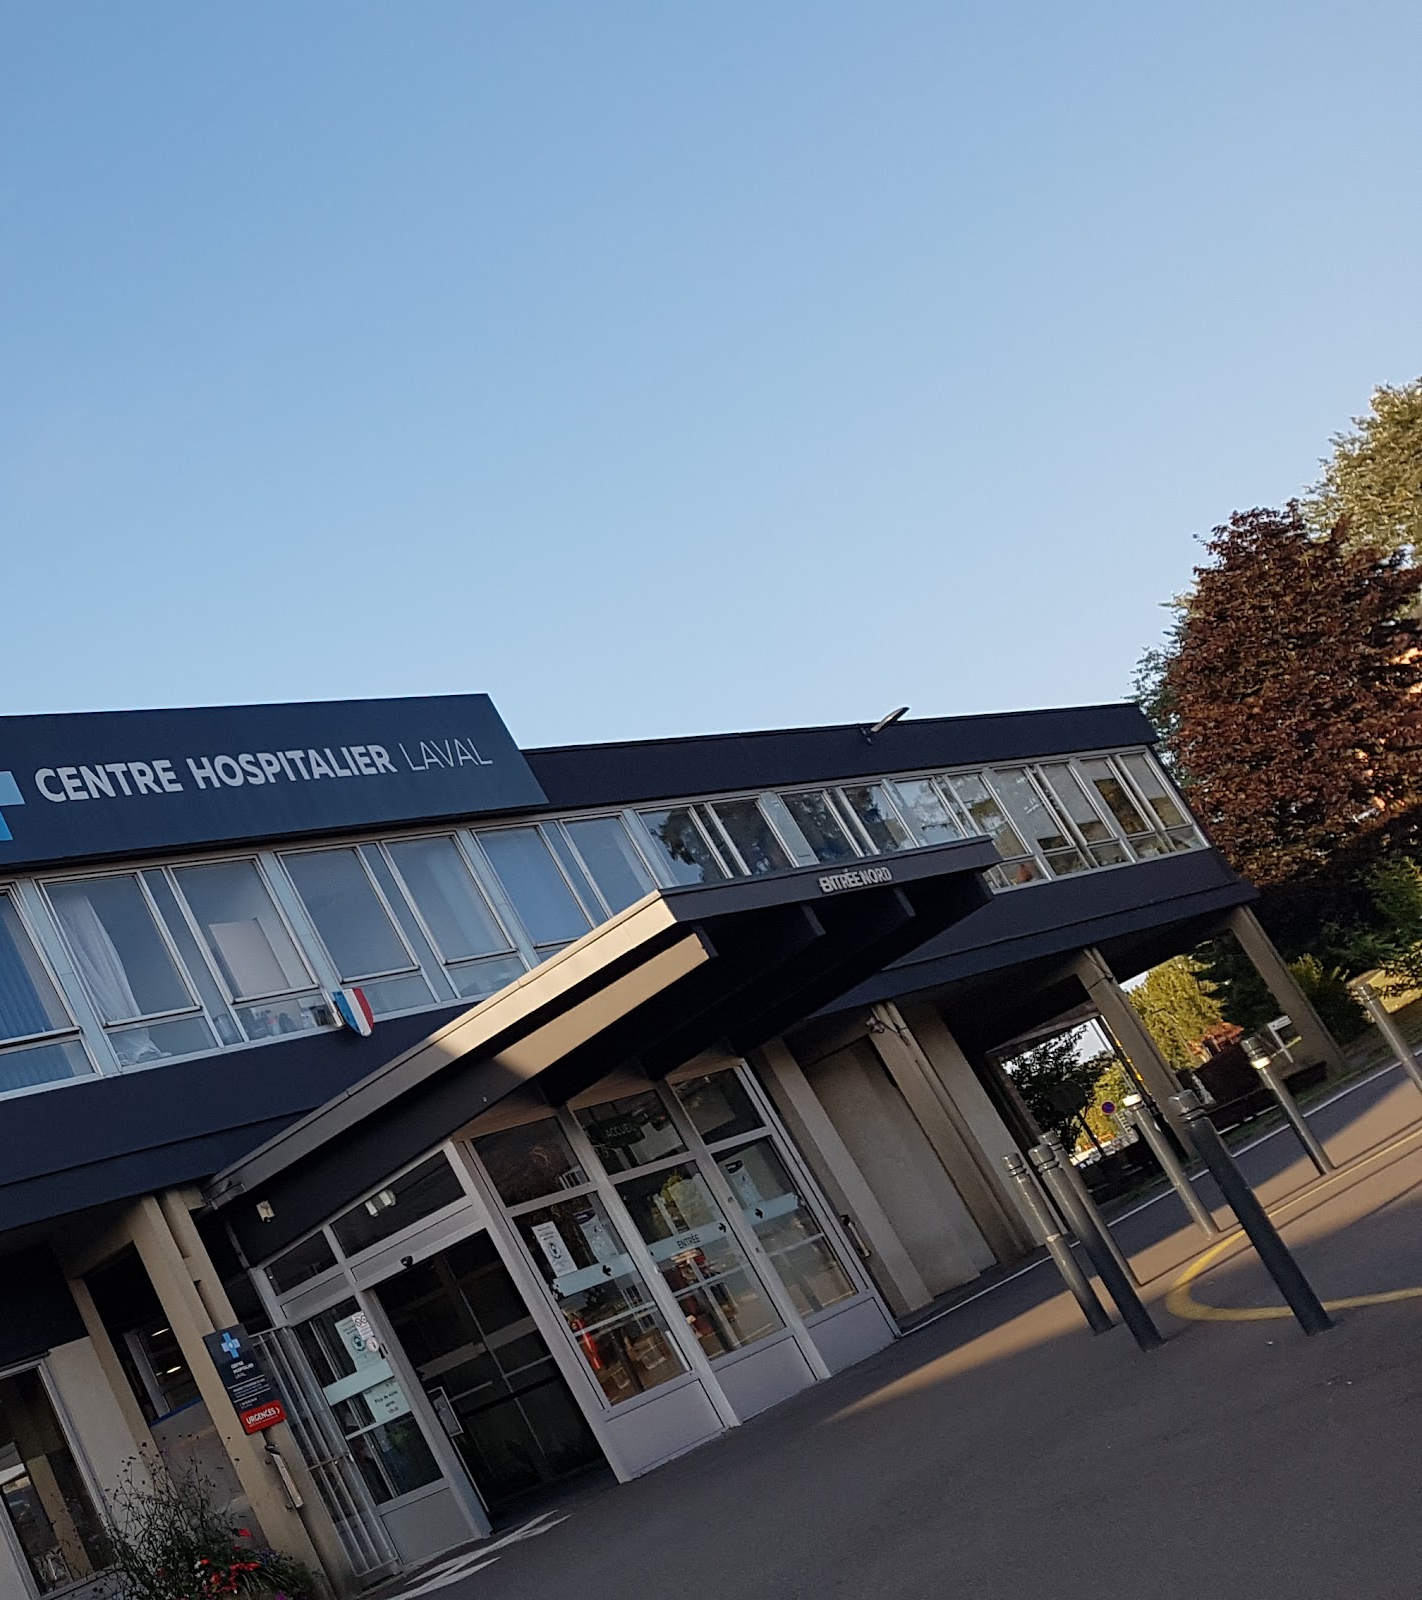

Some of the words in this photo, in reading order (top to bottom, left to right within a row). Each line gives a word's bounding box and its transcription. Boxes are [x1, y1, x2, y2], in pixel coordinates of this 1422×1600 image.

[35, 759, 184, 802] CENTRE
[186, 744, 398, 790] HOSPITALIER
[398, 737, 493, 771] LAVAL
[818, 868, 864, 893] ENTRÉE
[859, 866, 892, 885] NORD
[245, 1407, 277, 1425] URGENCES
